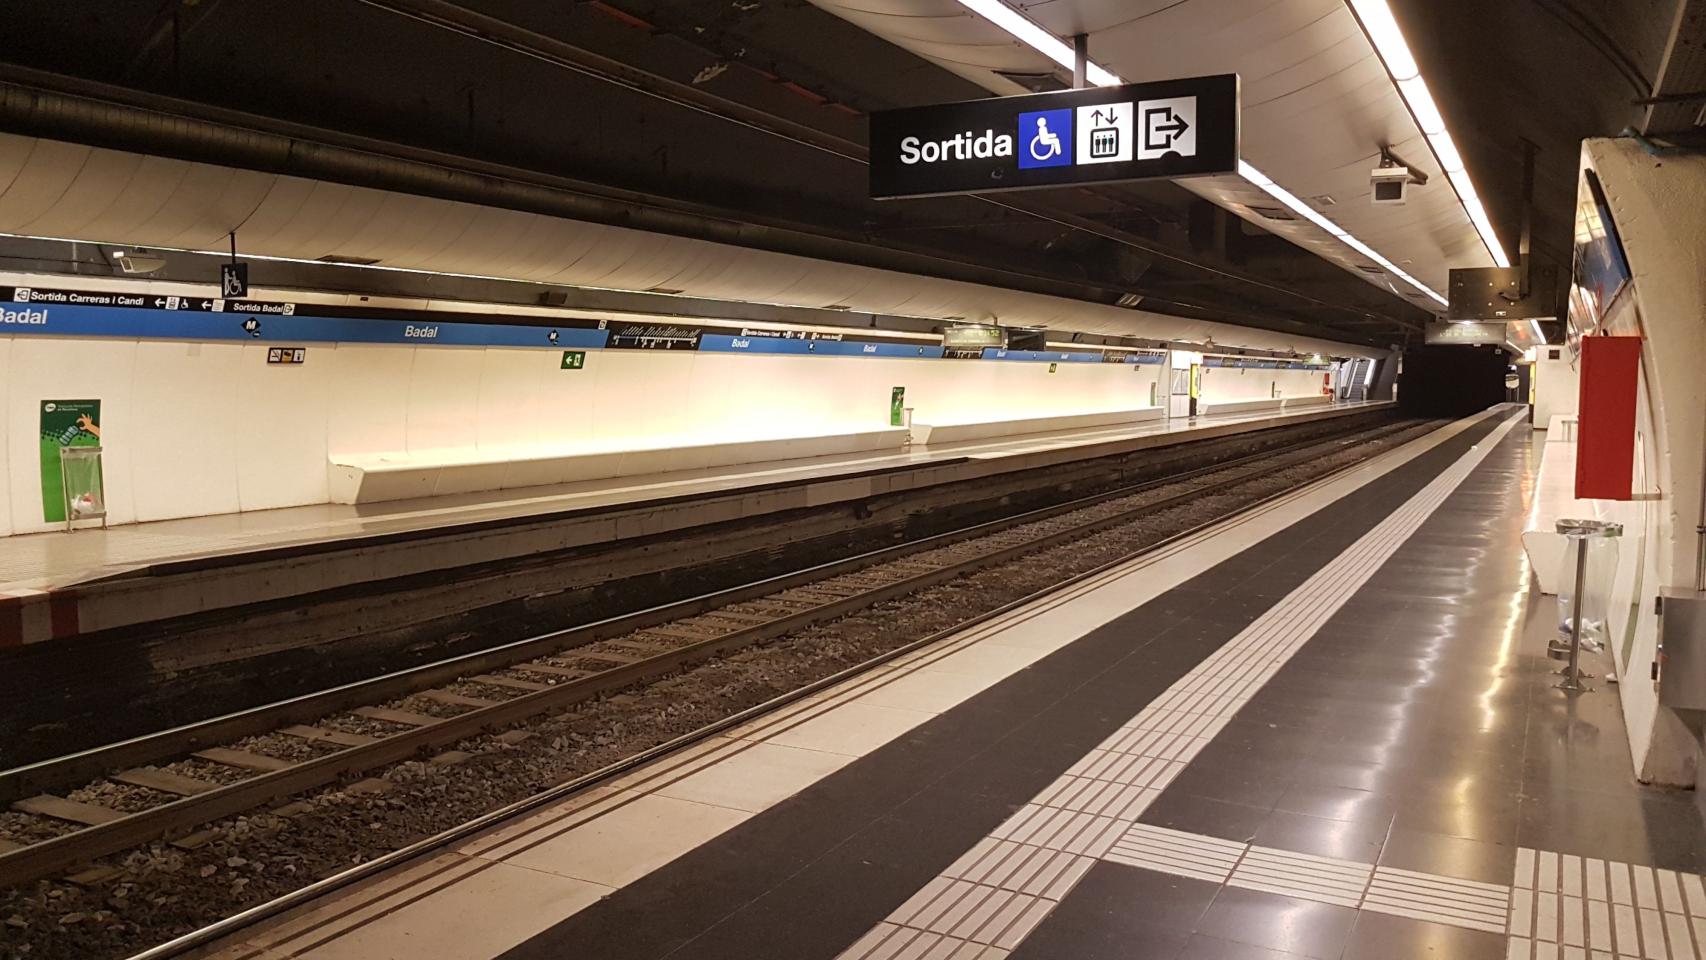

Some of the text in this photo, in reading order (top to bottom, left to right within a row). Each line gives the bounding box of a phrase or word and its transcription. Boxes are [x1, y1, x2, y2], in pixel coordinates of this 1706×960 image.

[900, 129, 1012, 164] Sortida
[31, 291, 67, 302] Sortida
[69, 293, 110, 304] Carreras
[118, 296, 144, 306] Candi
[233, 303, 283, 313] Sortida Badal
[404, 325, 439, 338] Badal
[731, 338, 750, 348] Badal
